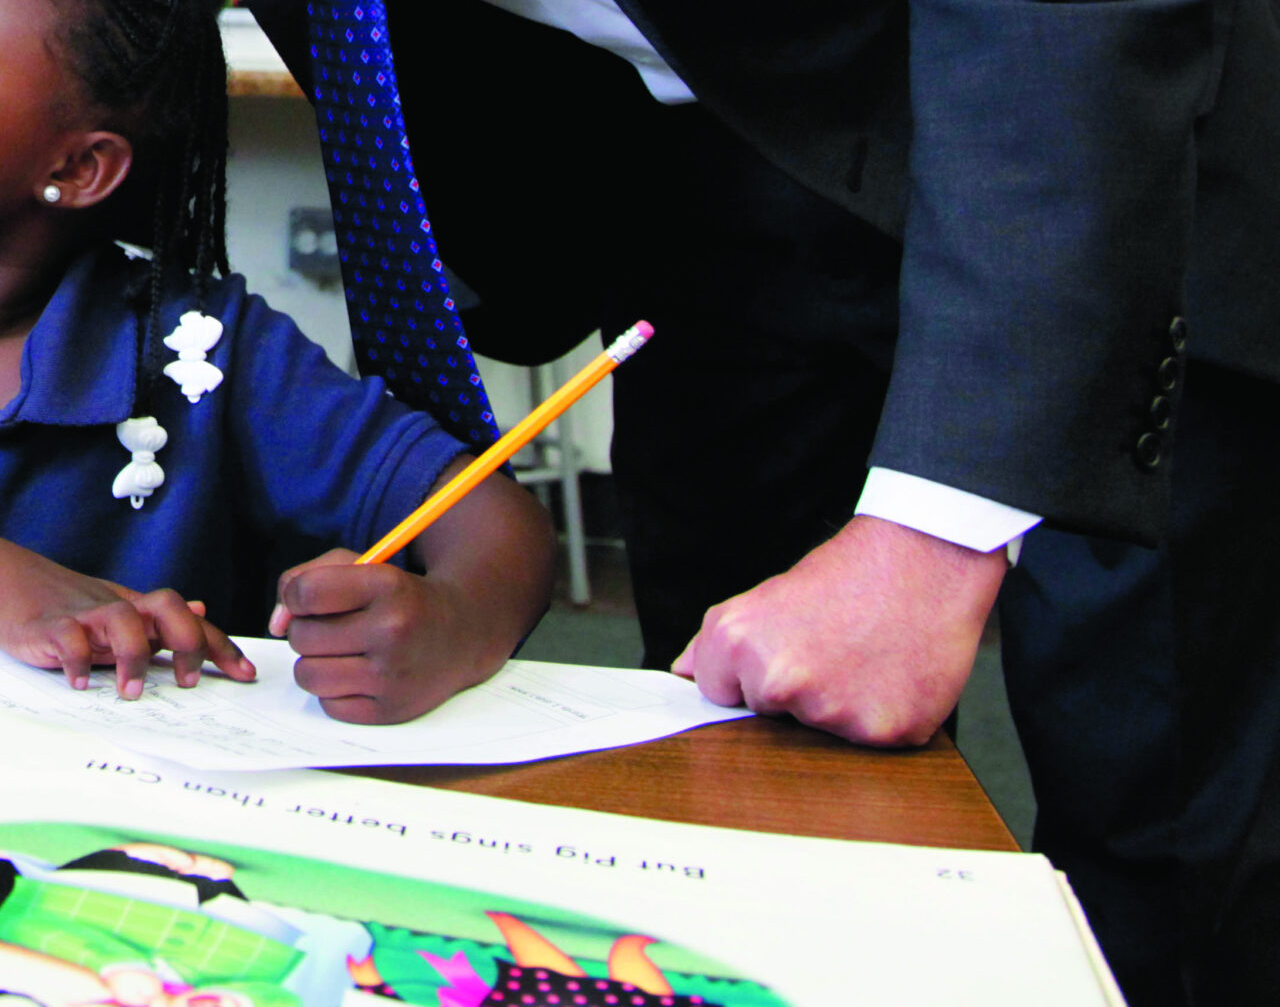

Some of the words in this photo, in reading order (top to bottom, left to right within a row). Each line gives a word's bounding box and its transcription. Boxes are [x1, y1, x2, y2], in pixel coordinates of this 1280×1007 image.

[86, 760, 162, 784] Cat!
[183, 781, 267, 808] than
[286, 804, 408, 838] better
[430, 829, 532, 854] sings
[555, 845, 617, 868] Pig
[638, 859, 706, 880] But
